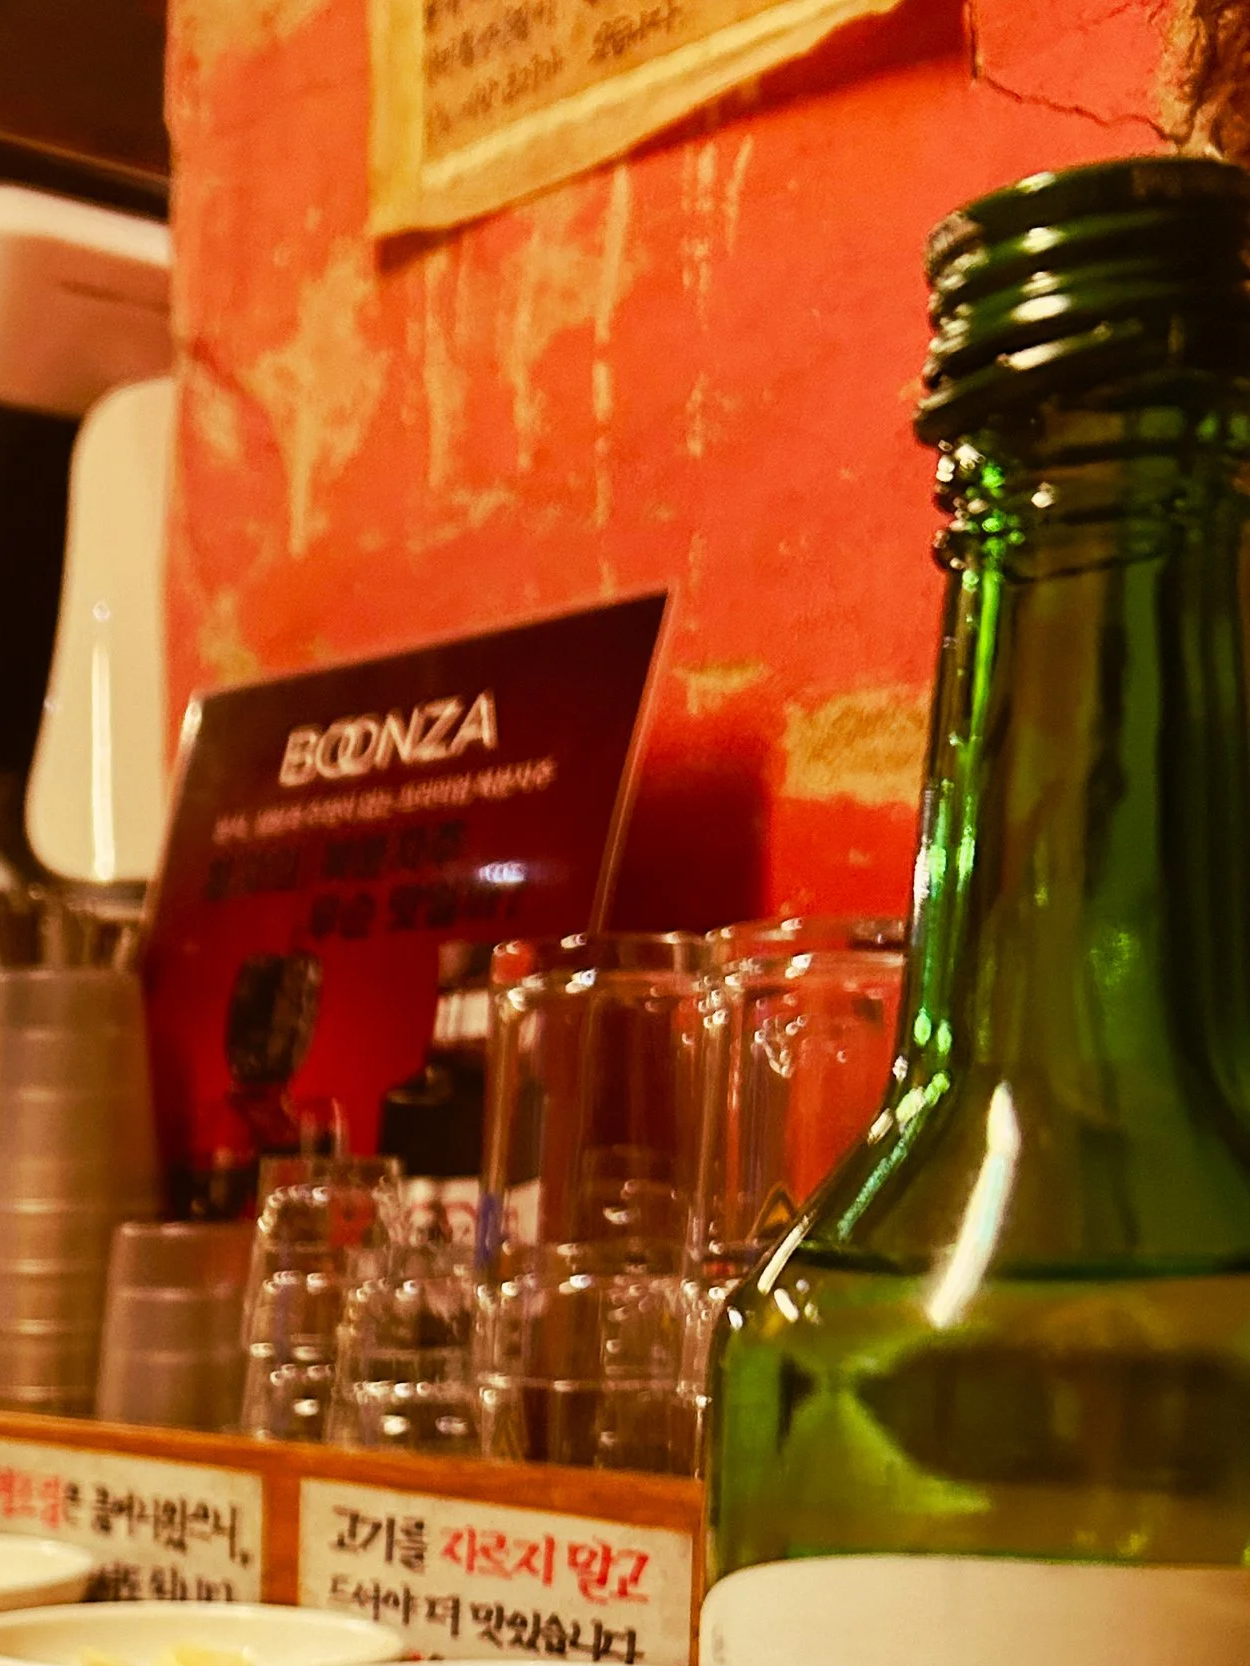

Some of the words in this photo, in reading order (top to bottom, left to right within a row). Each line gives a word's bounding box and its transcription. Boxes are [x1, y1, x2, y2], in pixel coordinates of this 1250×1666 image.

[279, 690, 498, 787] BOONZA
[331, 1504, 427, 1574] 고기를
[440, 1525, 556, 1586] 자르지
[566, 1539, 650, 1604] 말고
[468, 1601, 645, 1665] 맛있습니다
